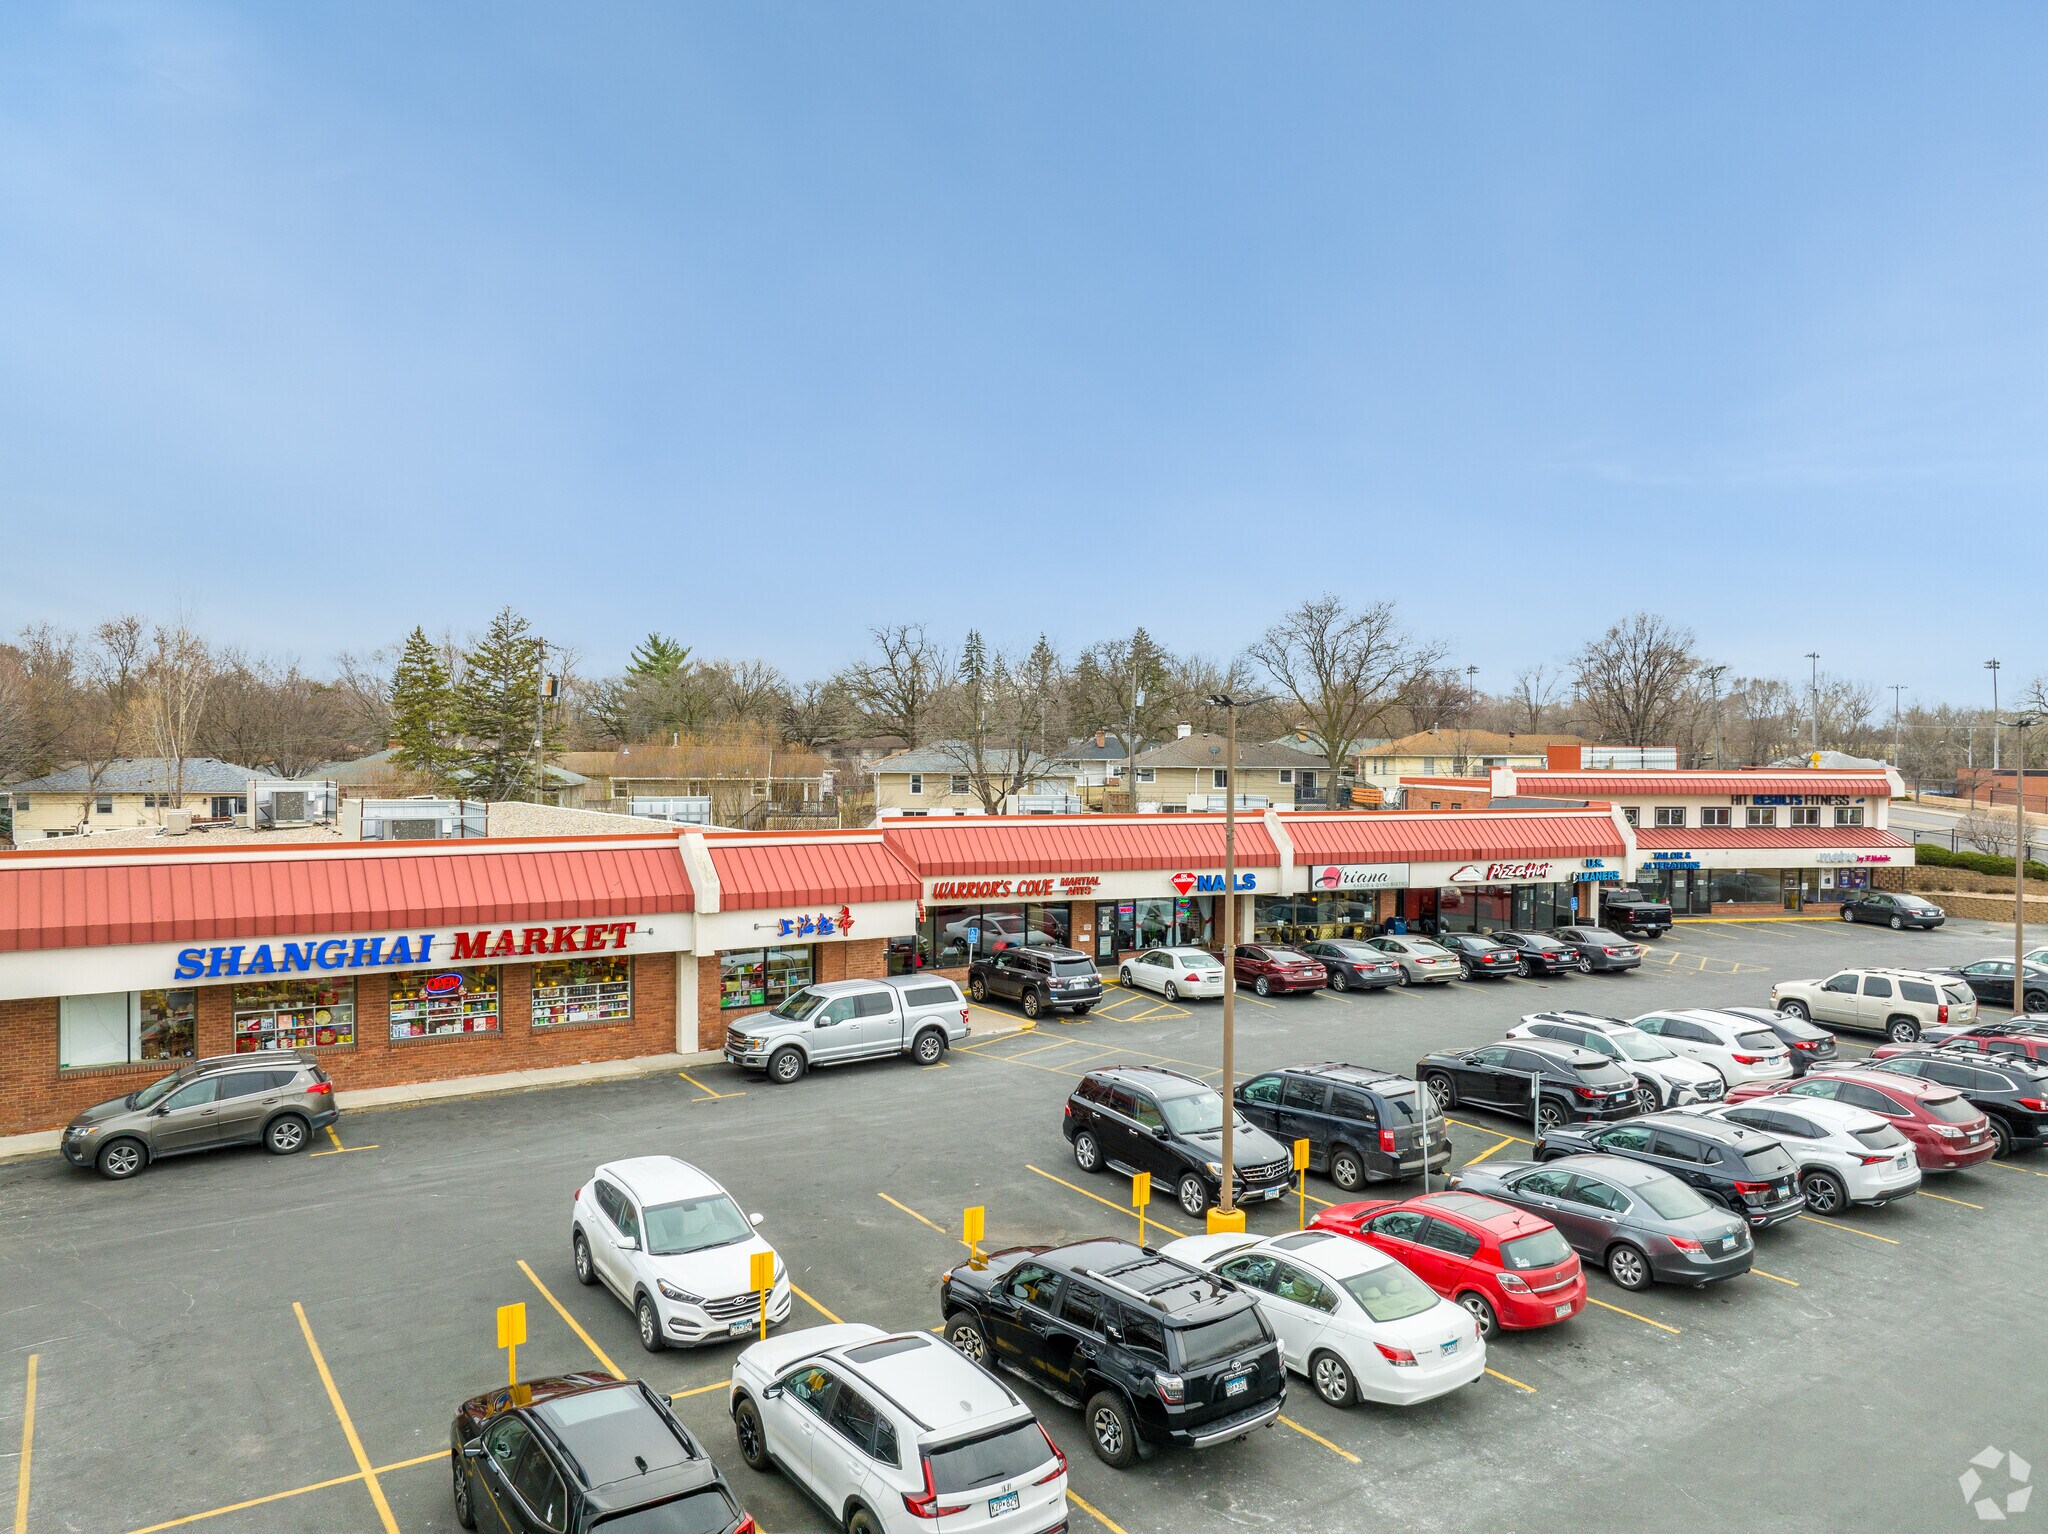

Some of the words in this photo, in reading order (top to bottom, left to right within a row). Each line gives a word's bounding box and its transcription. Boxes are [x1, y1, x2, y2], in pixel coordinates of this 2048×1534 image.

[1731, 795, 1748, 805] HIT
[1752, 794, 1803, 805] RESULTS
[1804, 795, 1850, 805] FITNESS
[1653, 852, 1684, 860] TAILOR
[1818, 851, 1857, 863] metro
[1486, 863, 1526, 881] Pizza
[1525, 862, 1553, 879] Hut
[1642, 862, 1701, 870] ALTERATIONS
[1060, 876, 1101, 886] MARTIAL
[1197, 873, 1256, 892] NALS
[1315, 866, 1390, 888] Ariana
[933, 880, 1012, 900] WARRIOR'S
[1017, 879, 1055, 897] COVE
[1066, 886, 1092, 896] ARTS
[174, 934, 435, 980] SHANGHAI
[450, 921, 636, 960] MARKET
[427, 976, 459, 990] OPEN
